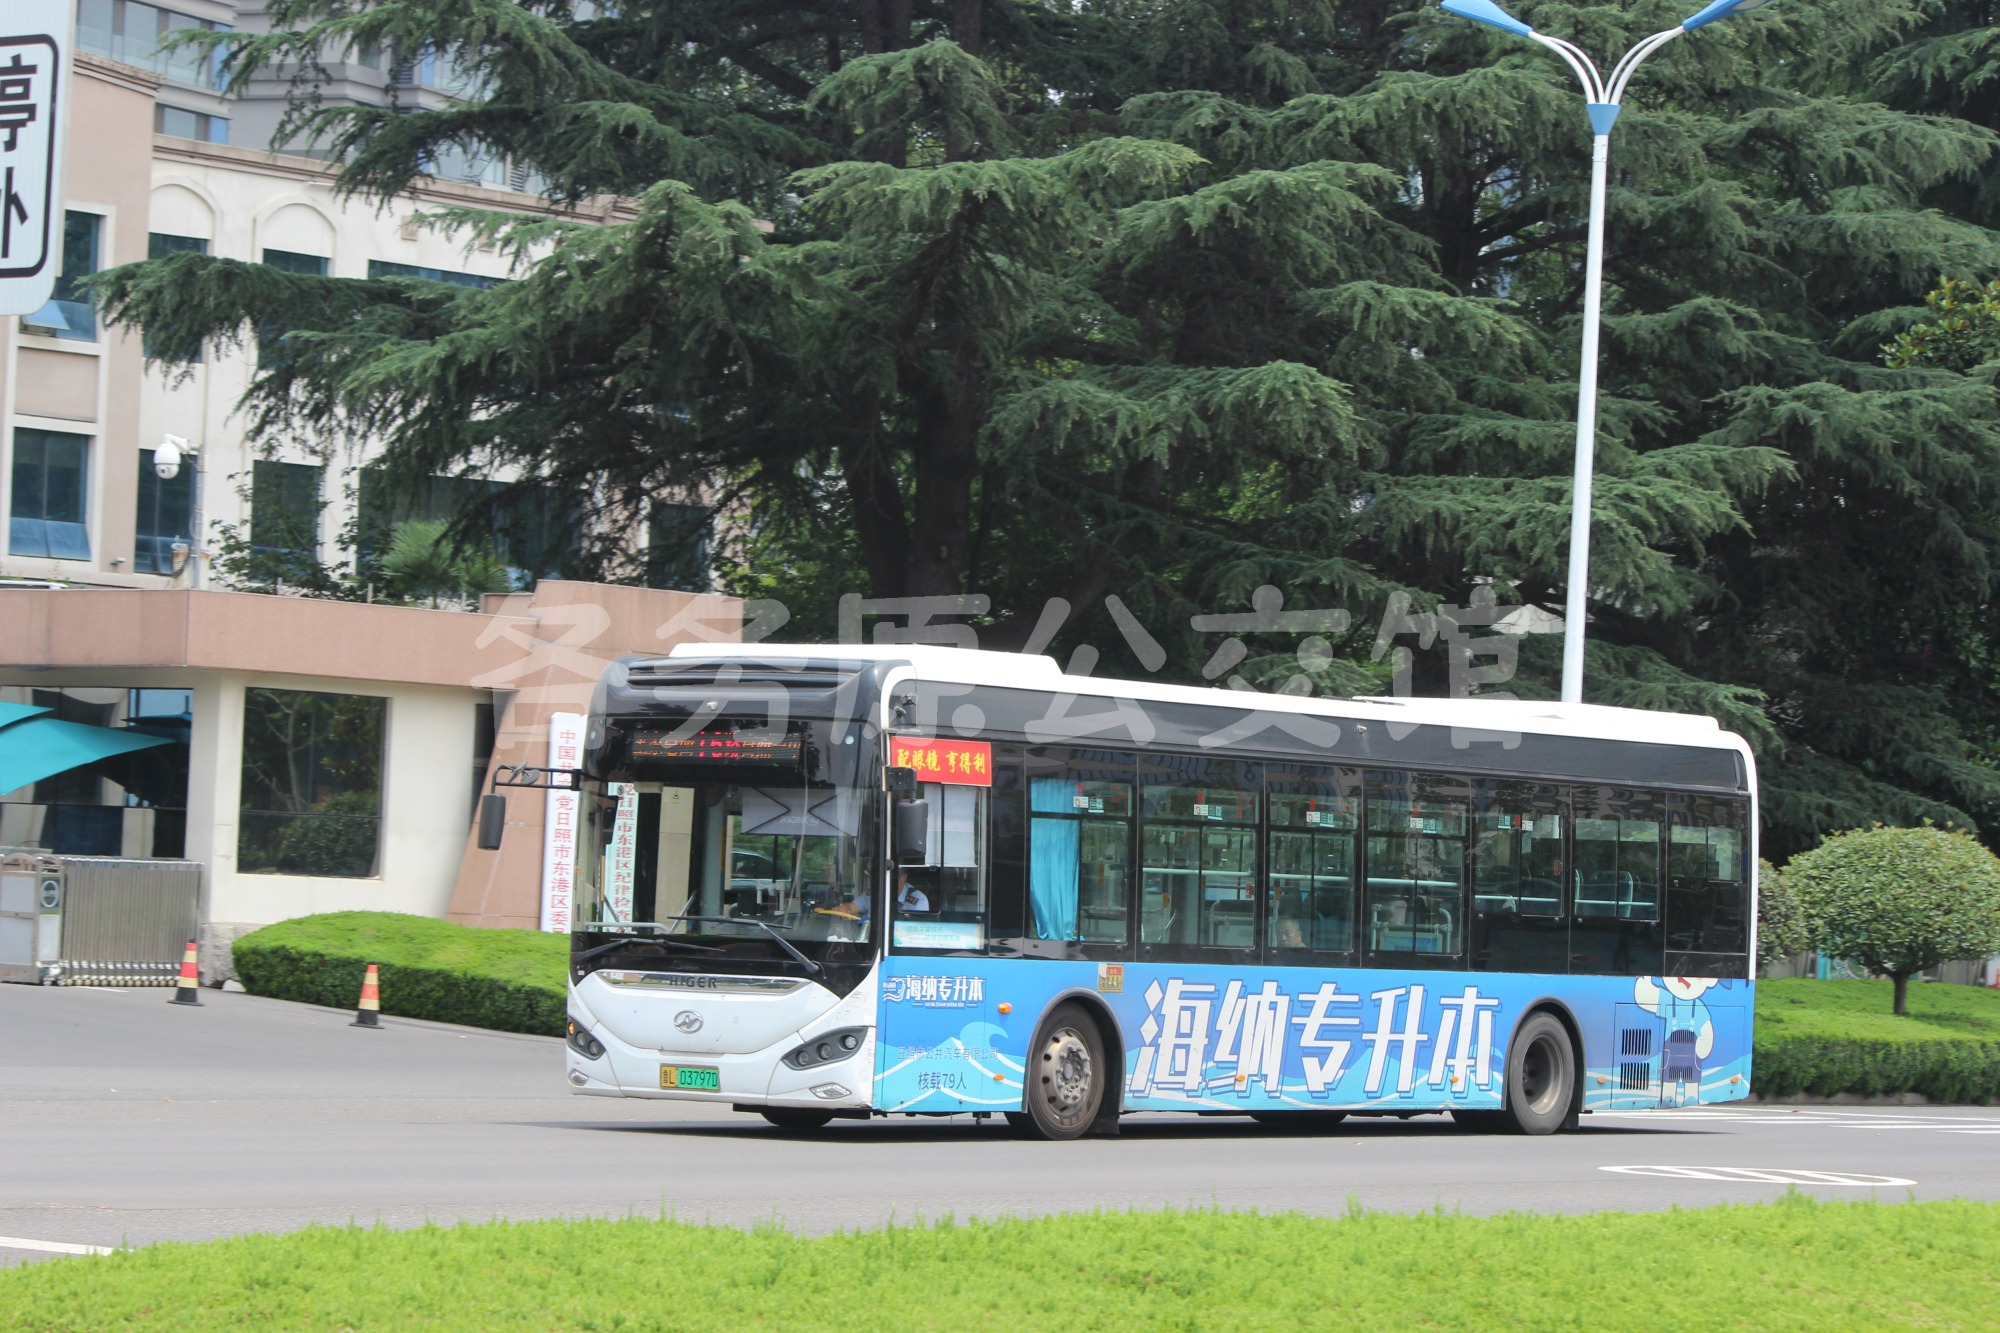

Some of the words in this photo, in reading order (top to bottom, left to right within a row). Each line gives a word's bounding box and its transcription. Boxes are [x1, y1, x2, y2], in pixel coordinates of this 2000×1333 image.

[897, 749, 941, 771] 配眼镜
[945, 751, 985, 774] 亨得利
[669, 976, 718, 988] HIGER
[905, 975, 983, 1001] 海纳专升本
[1129, 977, 1500, 1094] 海纳专升本
[918, 1071, 967, 1091] 核载79人
